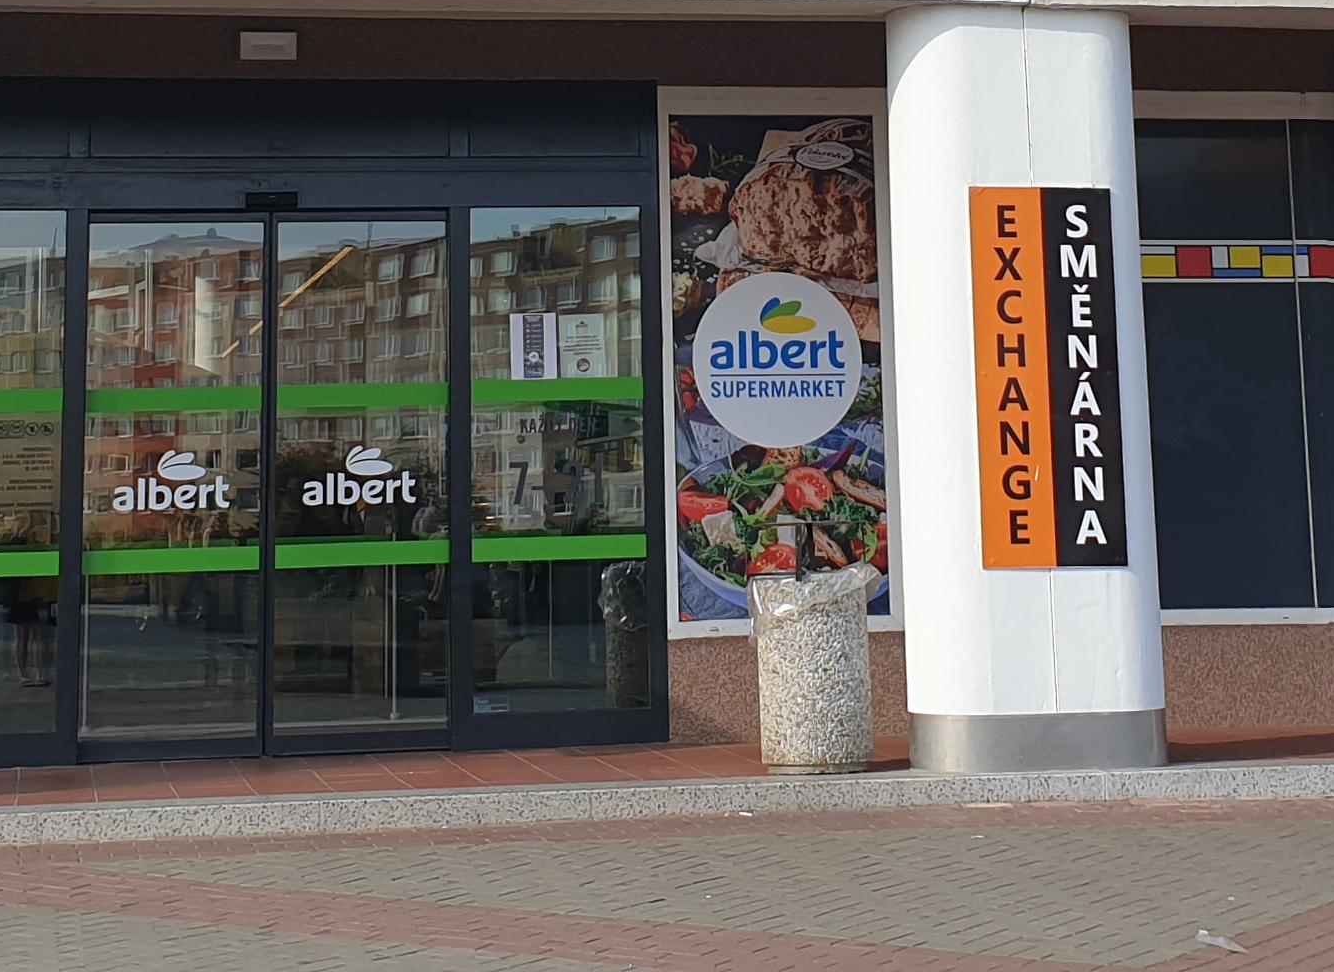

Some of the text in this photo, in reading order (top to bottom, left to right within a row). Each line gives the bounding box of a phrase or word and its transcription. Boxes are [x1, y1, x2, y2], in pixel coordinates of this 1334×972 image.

[709, 329, 845, 371] albert
[709, 379, 846, 400] SUPERMARKET
[993, 204, 1032, 546] EXCHANGE
[1059, 203, 1108, 546] SMĚNÁRNA
[112, 474, 231, 512] albert
[302, 470, 417, 506] albert
